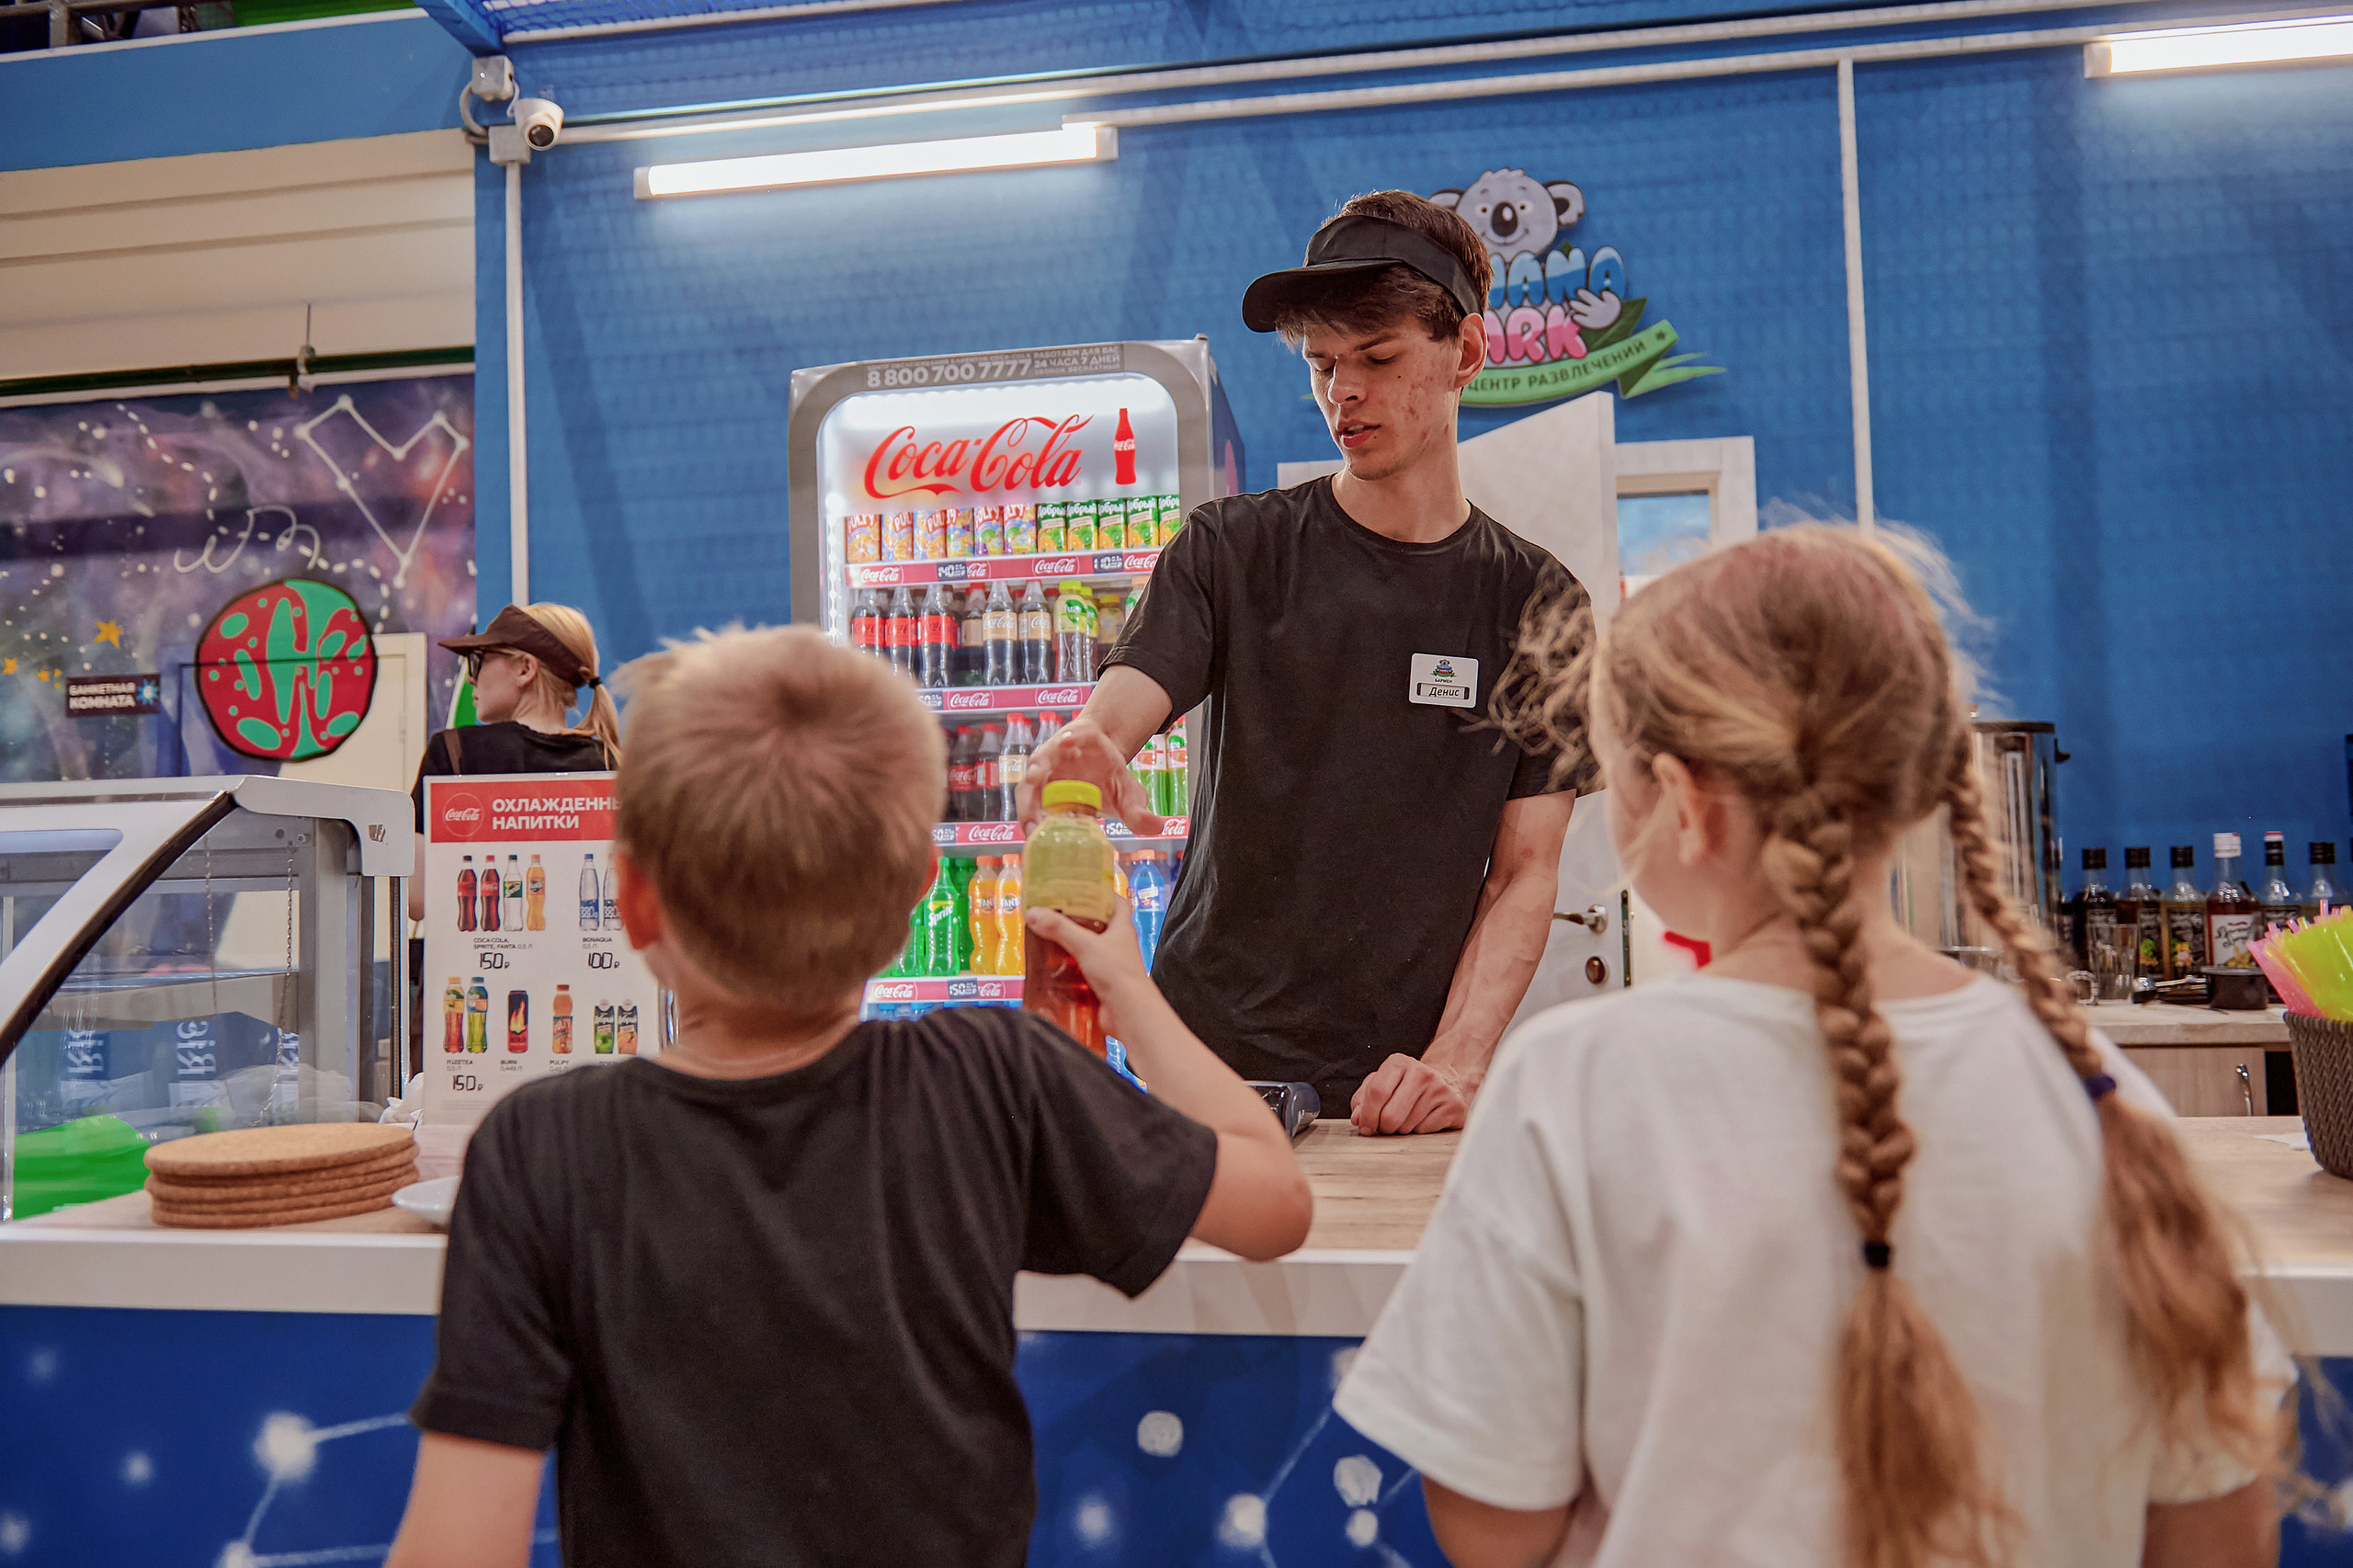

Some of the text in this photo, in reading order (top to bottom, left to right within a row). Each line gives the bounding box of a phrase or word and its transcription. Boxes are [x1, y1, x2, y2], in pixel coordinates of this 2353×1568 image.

[1483, 304, 1588, 365] ARK
[1033, 354, 1120, 368] 24 ЧАСА 7 ДНЕЙ
[1468, 339, 1647, 392] ЦЕНТР РАЗВЛЕЧЕНИЙ
[867, 358, 1032, 387] 8 800 700 7777
[864, 414, 1095, 499] Coca-Cola
[1034, 557, 1076, 574] Coca-Cola
[949, 692, 991, 708] Coca-Cola
[1037, 688, 1080, 705] Coca-Cola
[1428, 687, 1461, 698] Денис
[69, 694, 136, 710] КОМНАТА
[492, 814, 580, 830] НАПИТКИ
[968, 824, 1015, 841] Coca-Cola
